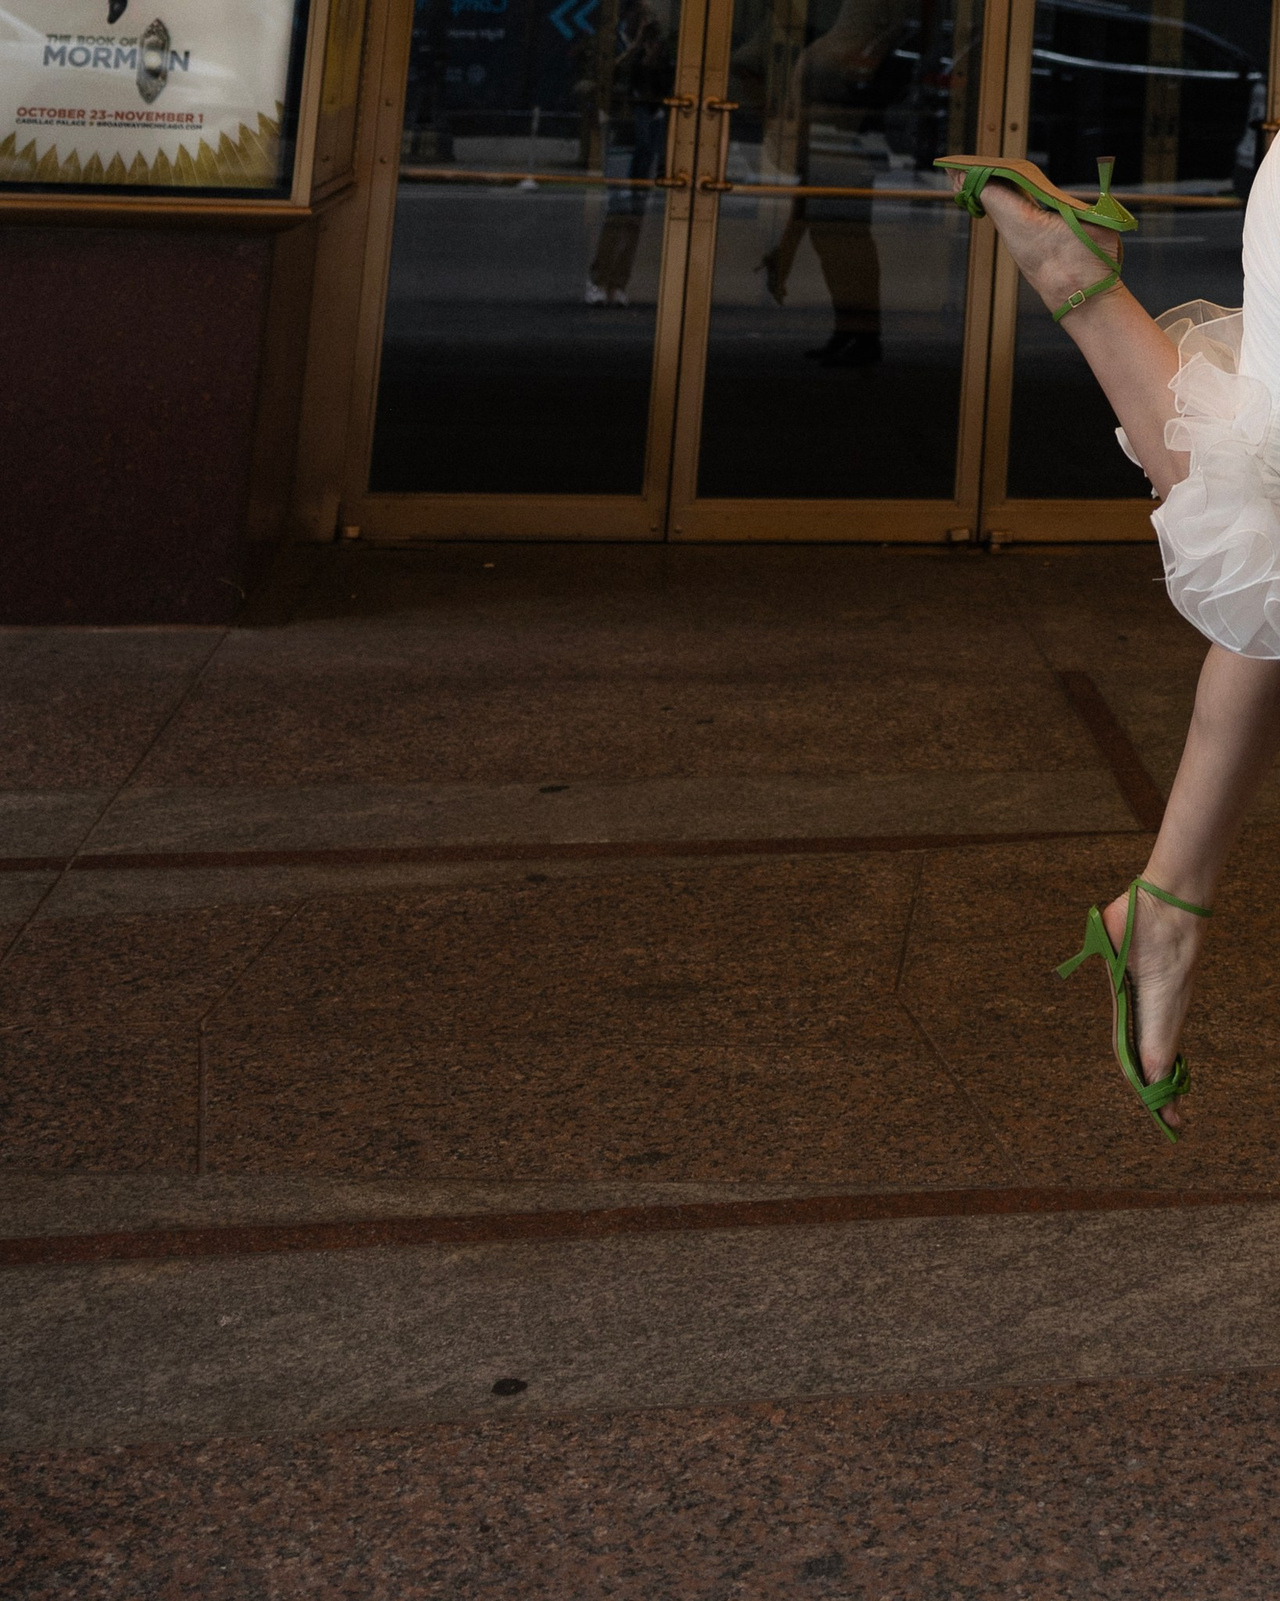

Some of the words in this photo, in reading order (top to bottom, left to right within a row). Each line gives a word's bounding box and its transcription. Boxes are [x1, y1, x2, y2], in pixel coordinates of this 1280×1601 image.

[47, 34, 71, 44] THE
[77, 35, 115, 45] BOOK
[119, 37, 138, 47] OF
[17, 106, 86, 120] OCTOBER
[16, 118, 54, 126] CADILLAC
